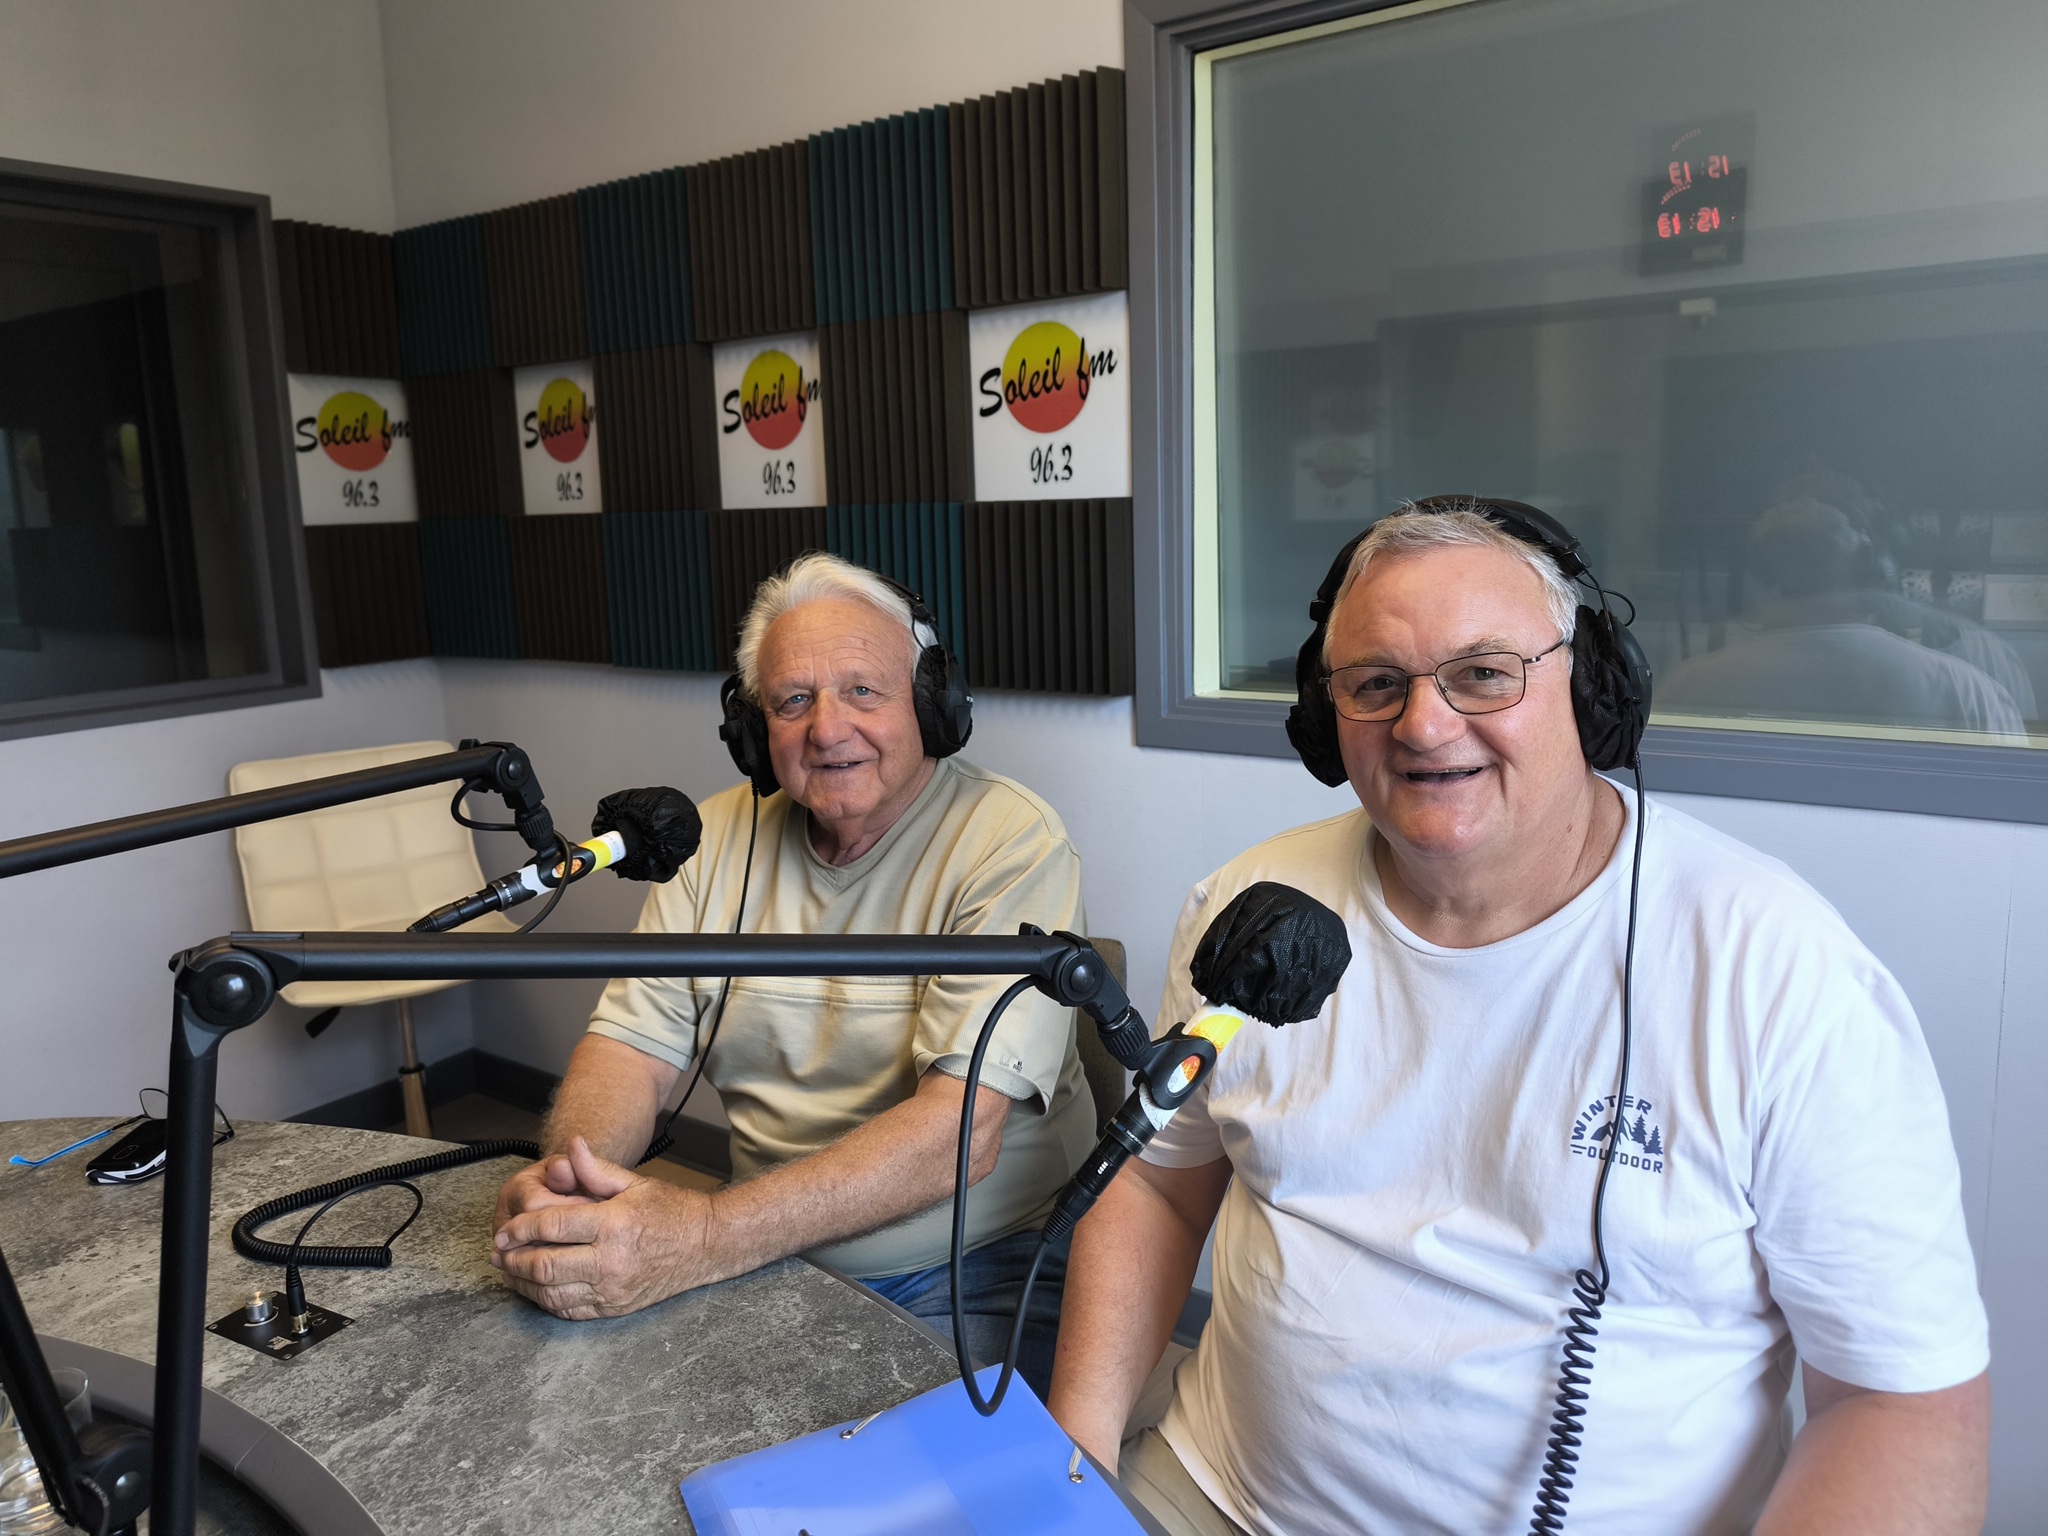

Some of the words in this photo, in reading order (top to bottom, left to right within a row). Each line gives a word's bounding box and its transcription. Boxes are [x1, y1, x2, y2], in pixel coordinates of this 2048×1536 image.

[979, 346, 1065, 417] Soleil
[1076, 337, 1117, 401] fm
[524, 398, 576, 449] Soleil
[724, 373, 788, 434] Soleil
[296, 411, 371, 453] Soleil
[381, 408, 411, 453] fm
[556, 471, 584, 501] 96.3
[763, 460, 796, 495] 96.3
[1030, 444, 1073, 484] 96.3
[343, 480, 380, 507] 96.3
[1571, 1095, 1652, 1140] WINTER
